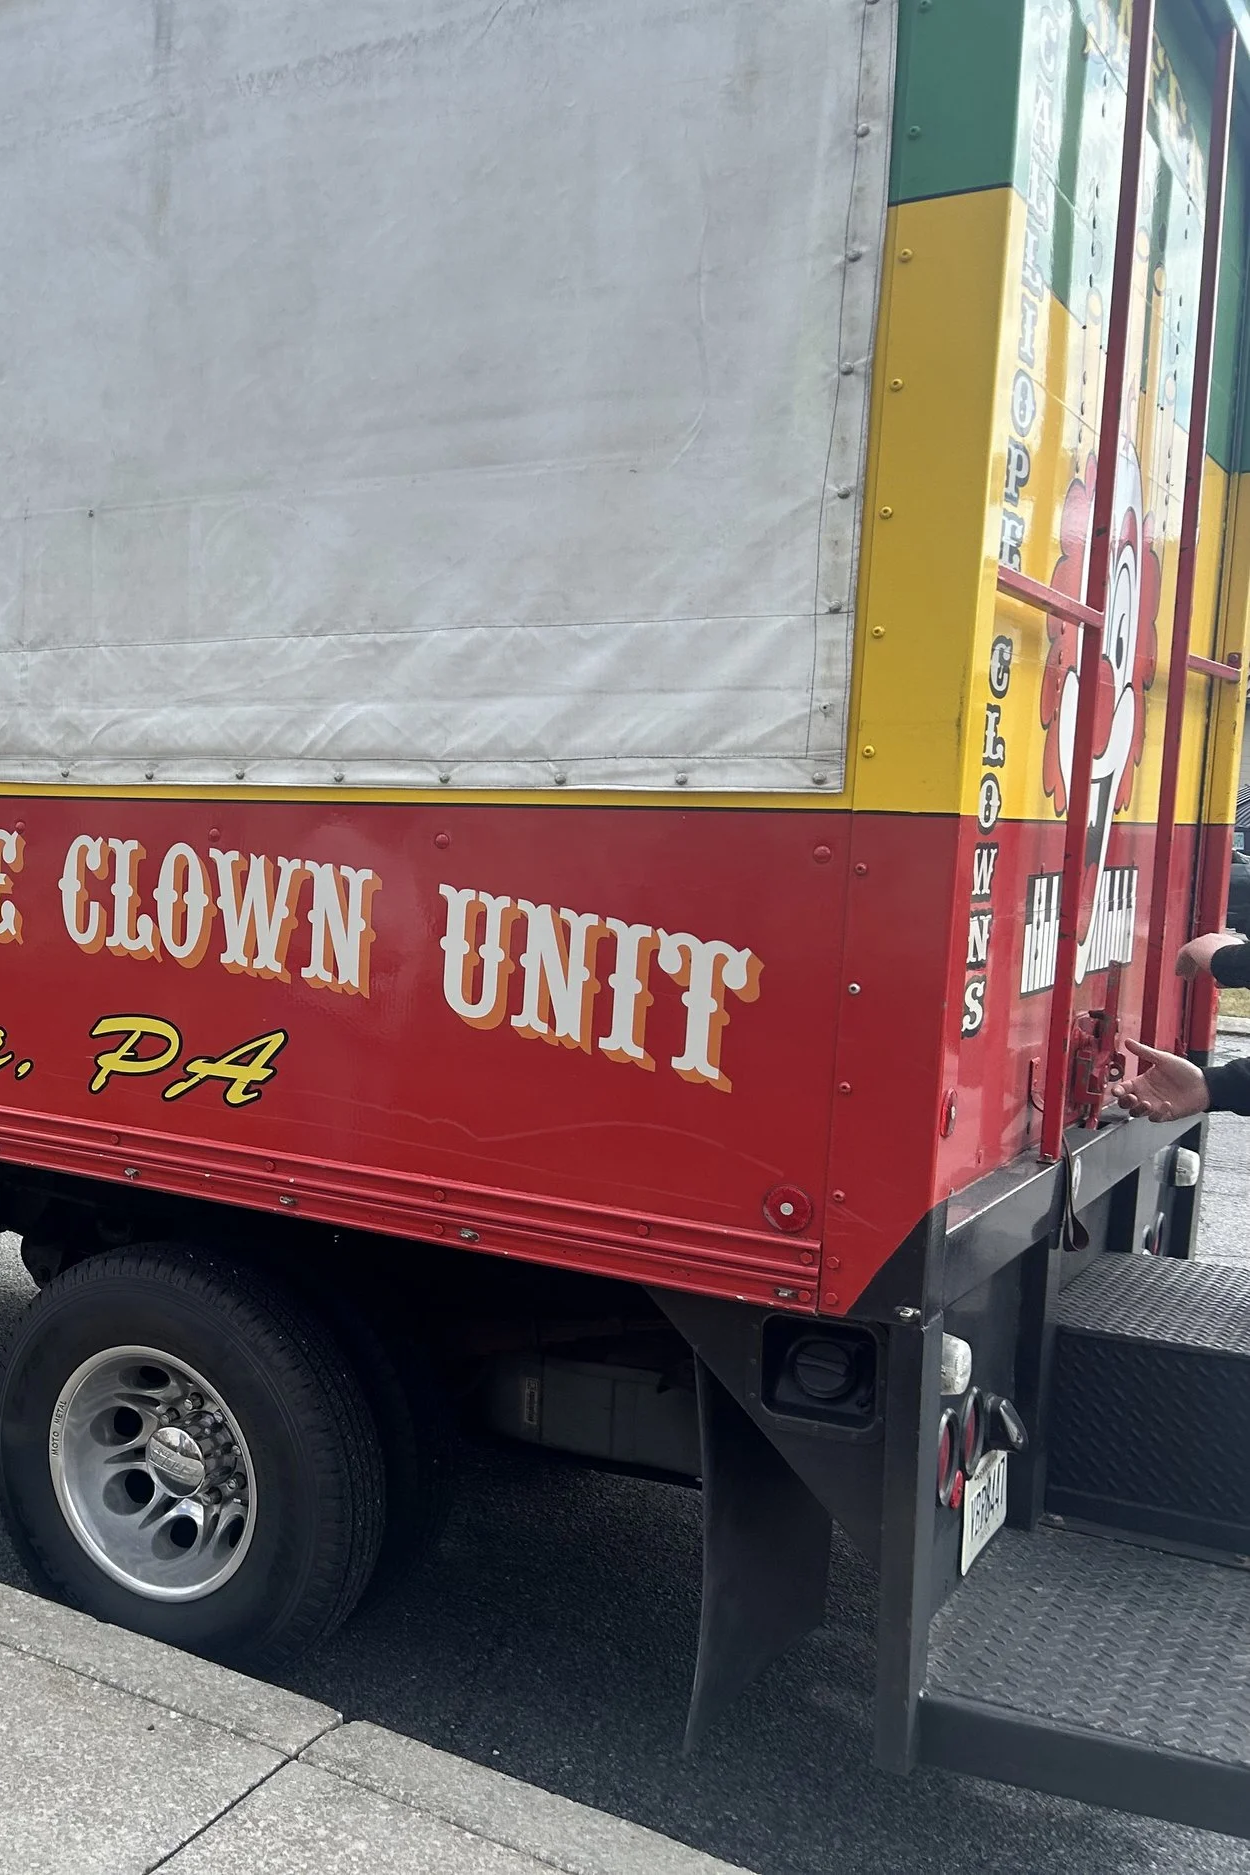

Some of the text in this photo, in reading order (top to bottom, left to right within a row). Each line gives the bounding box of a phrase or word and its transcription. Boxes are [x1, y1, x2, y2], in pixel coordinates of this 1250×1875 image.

[961, 5, 1059, 1038] CALLIOPE CLOWNS
[59, 834, 383, 999] CLOWN
[439, 883, 764, 1093] UNIT
[89, 1013, 288, 1108] PA
[51, 1400, 67, 1457] MOTO METAL
